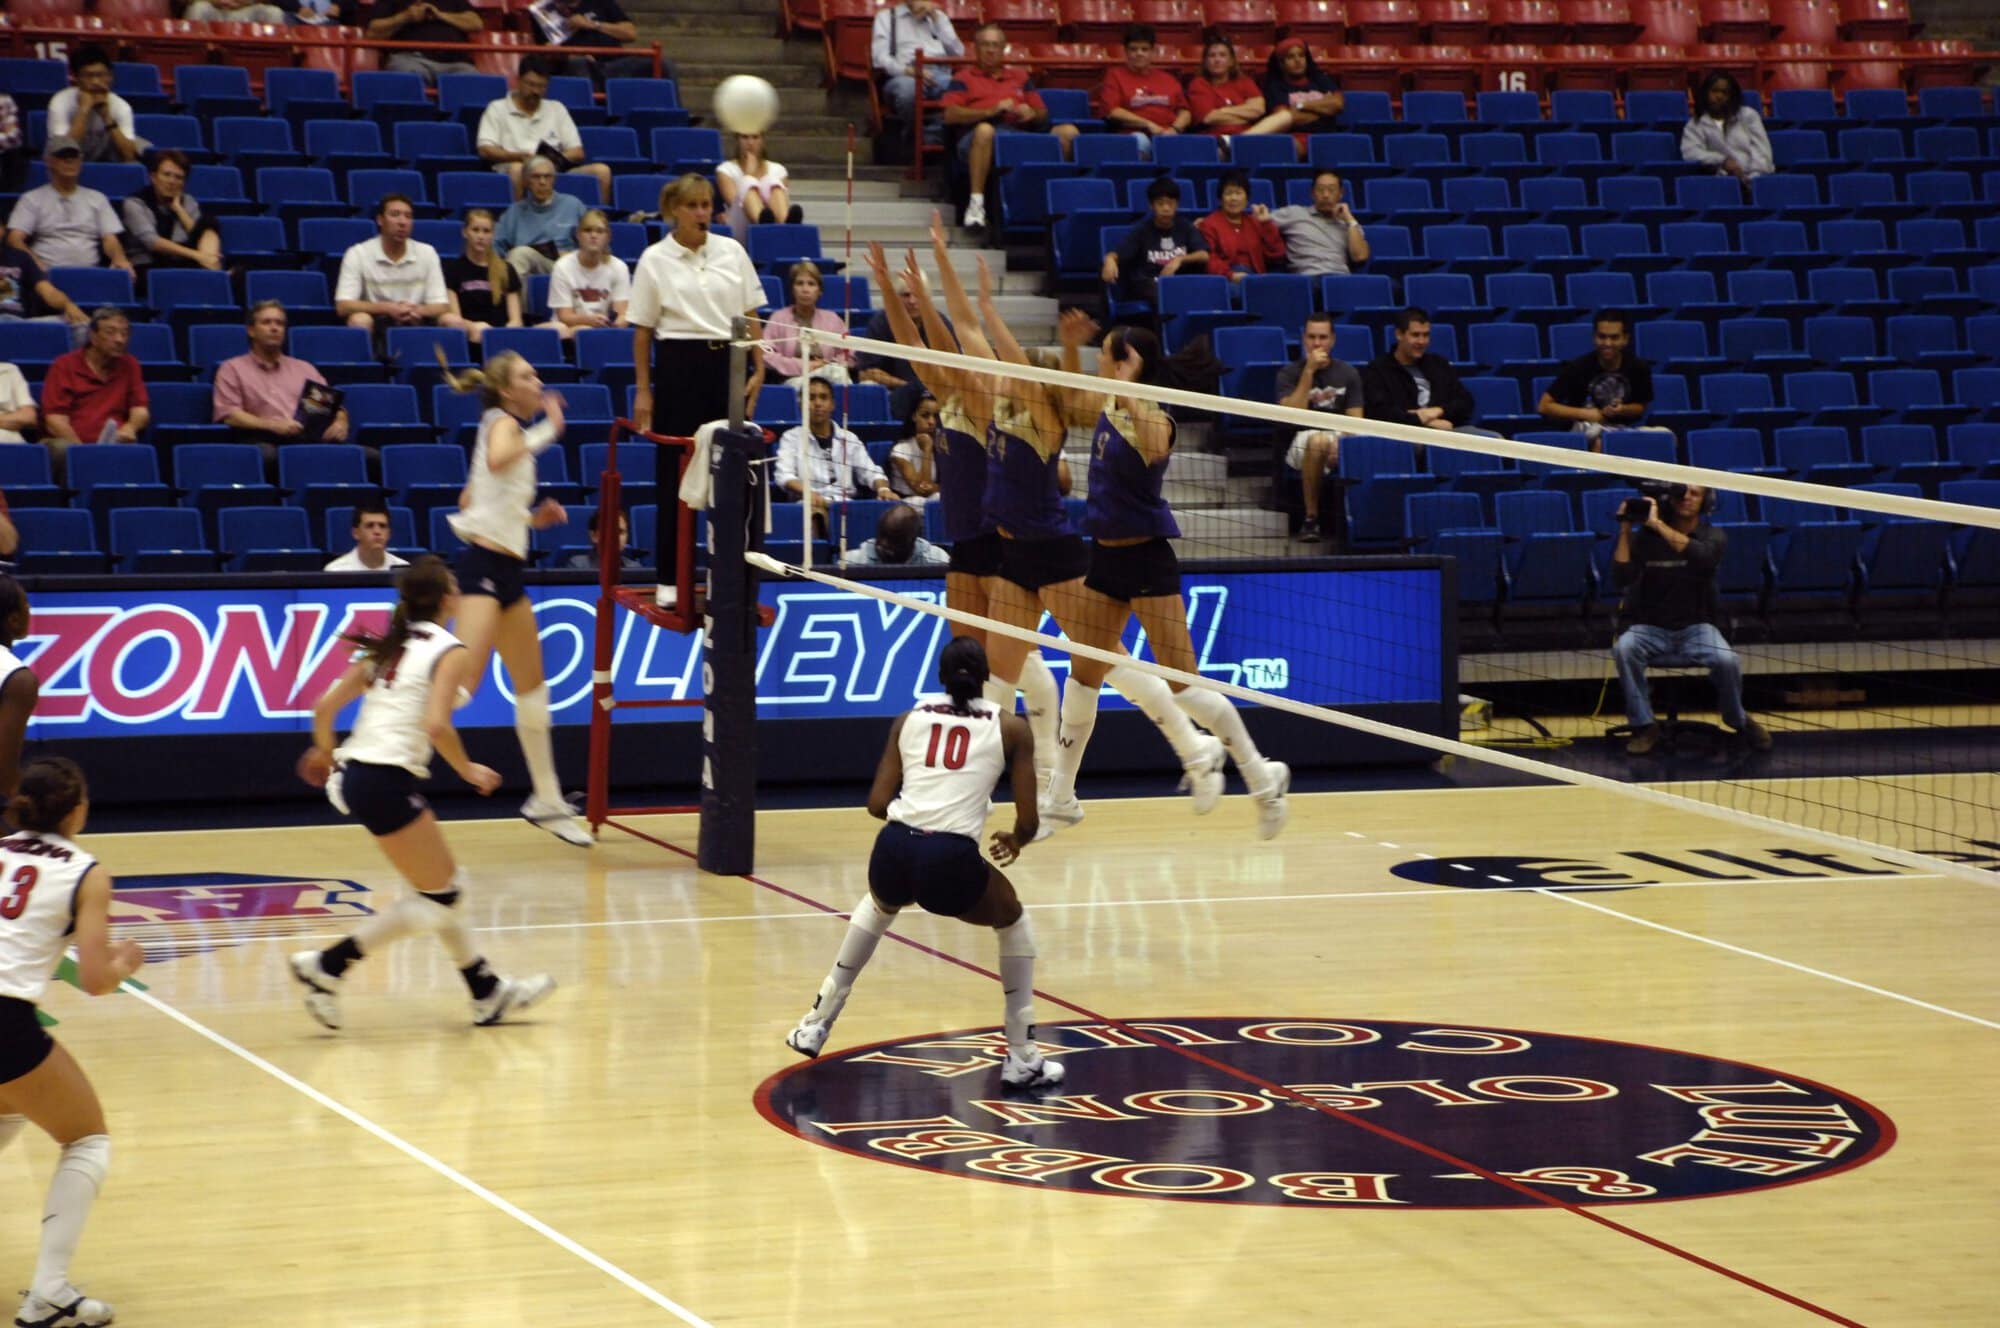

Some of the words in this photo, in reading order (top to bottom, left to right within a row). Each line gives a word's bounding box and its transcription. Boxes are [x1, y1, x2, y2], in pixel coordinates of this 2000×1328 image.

[34, 41, 69, 62] 15
[1499, 71, 1527, 93] 16
[1244, 660, 1286, 686] TM
[924, 723, 971, 770] 10
[0, 861, 39, 920] 3
[843, 1021, 1533, 1079] COURT
[967, 1074, 1620, 1127] OLSON
[1635, 1080, 1863, 1177] LUTE
[808, 1114, 1414, 1204] BOBBI
